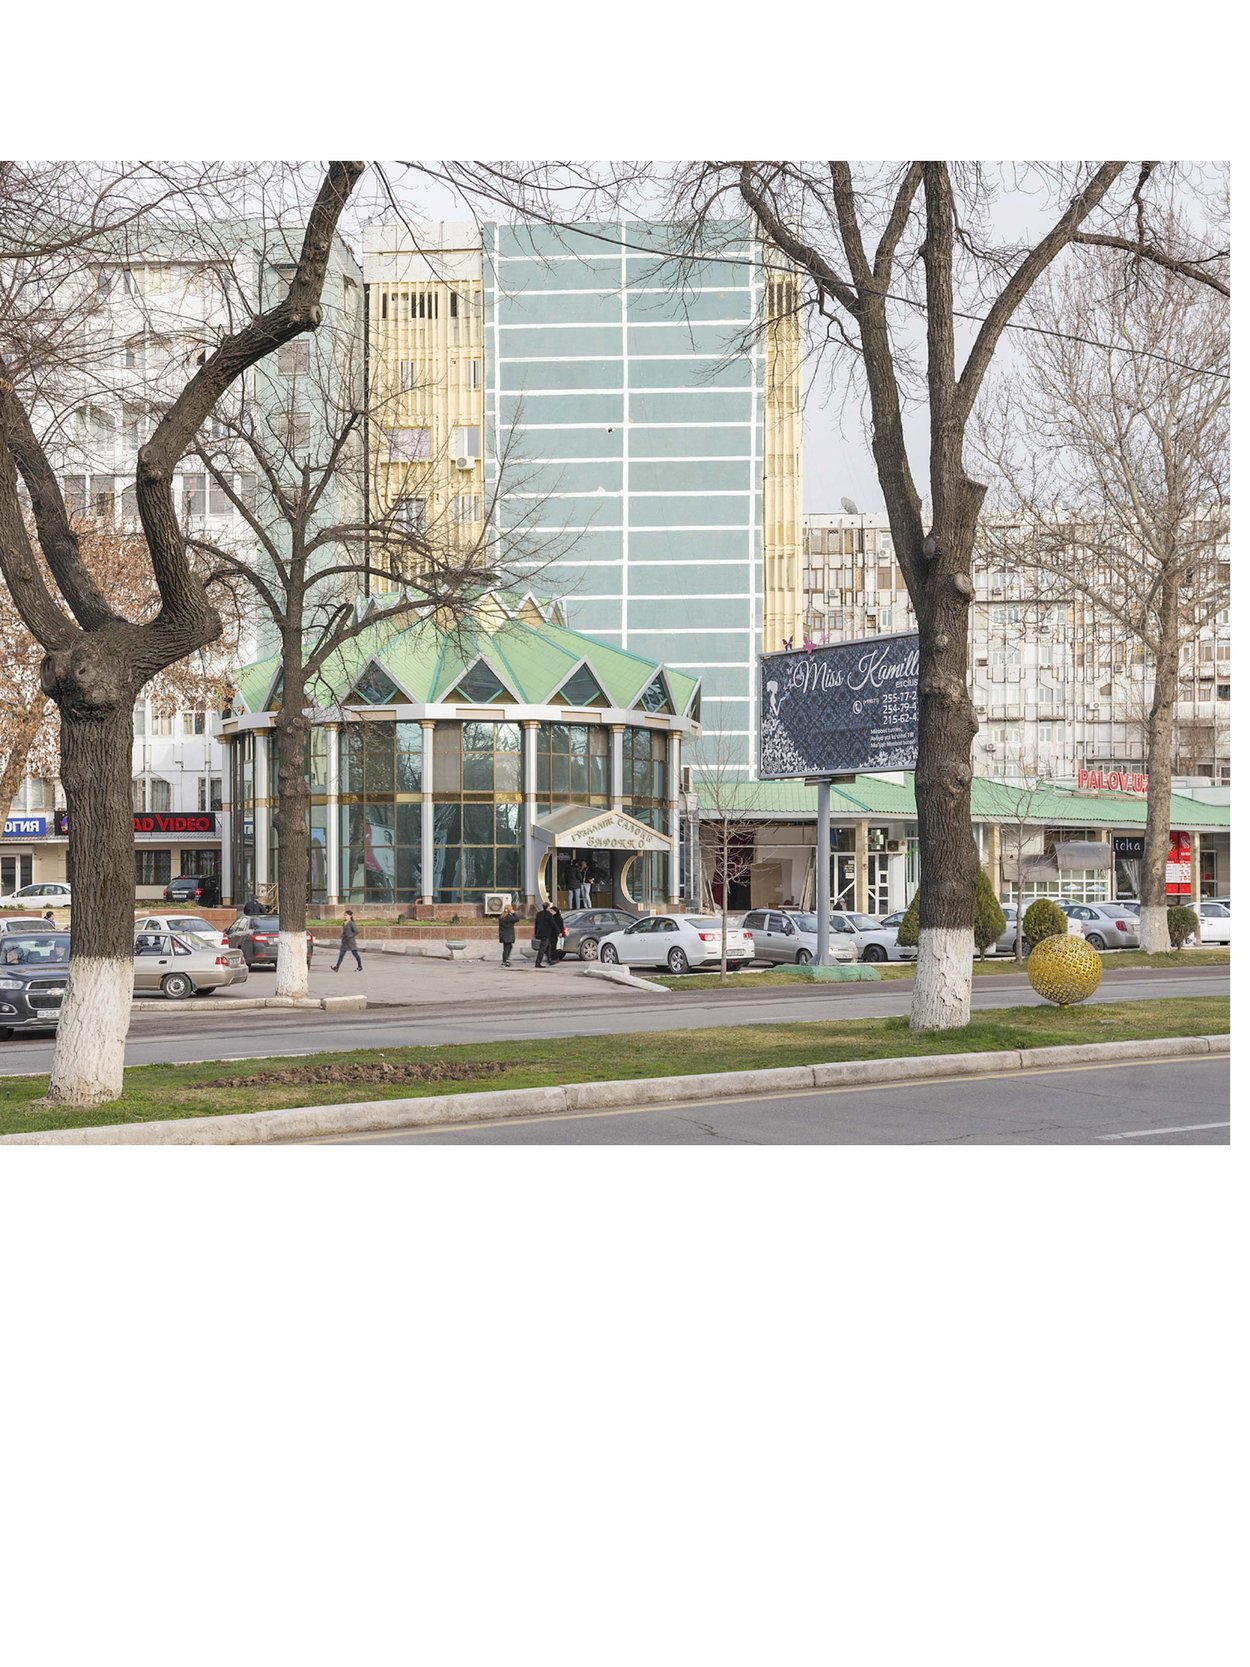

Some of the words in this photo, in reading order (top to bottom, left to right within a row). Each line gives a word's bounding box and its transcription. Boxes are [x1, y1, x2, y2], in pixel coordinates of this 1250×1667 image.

[793, 660, 845, 693] Miss
[847, 645, 920, 691] Kamill
[883, 691, 918, 704] 255-77-2
[883, 702, 919, 714] 254-79-4
[883, 712, 919, 725] 215-62-4
[154, 813, 210, 833] VIDEO
